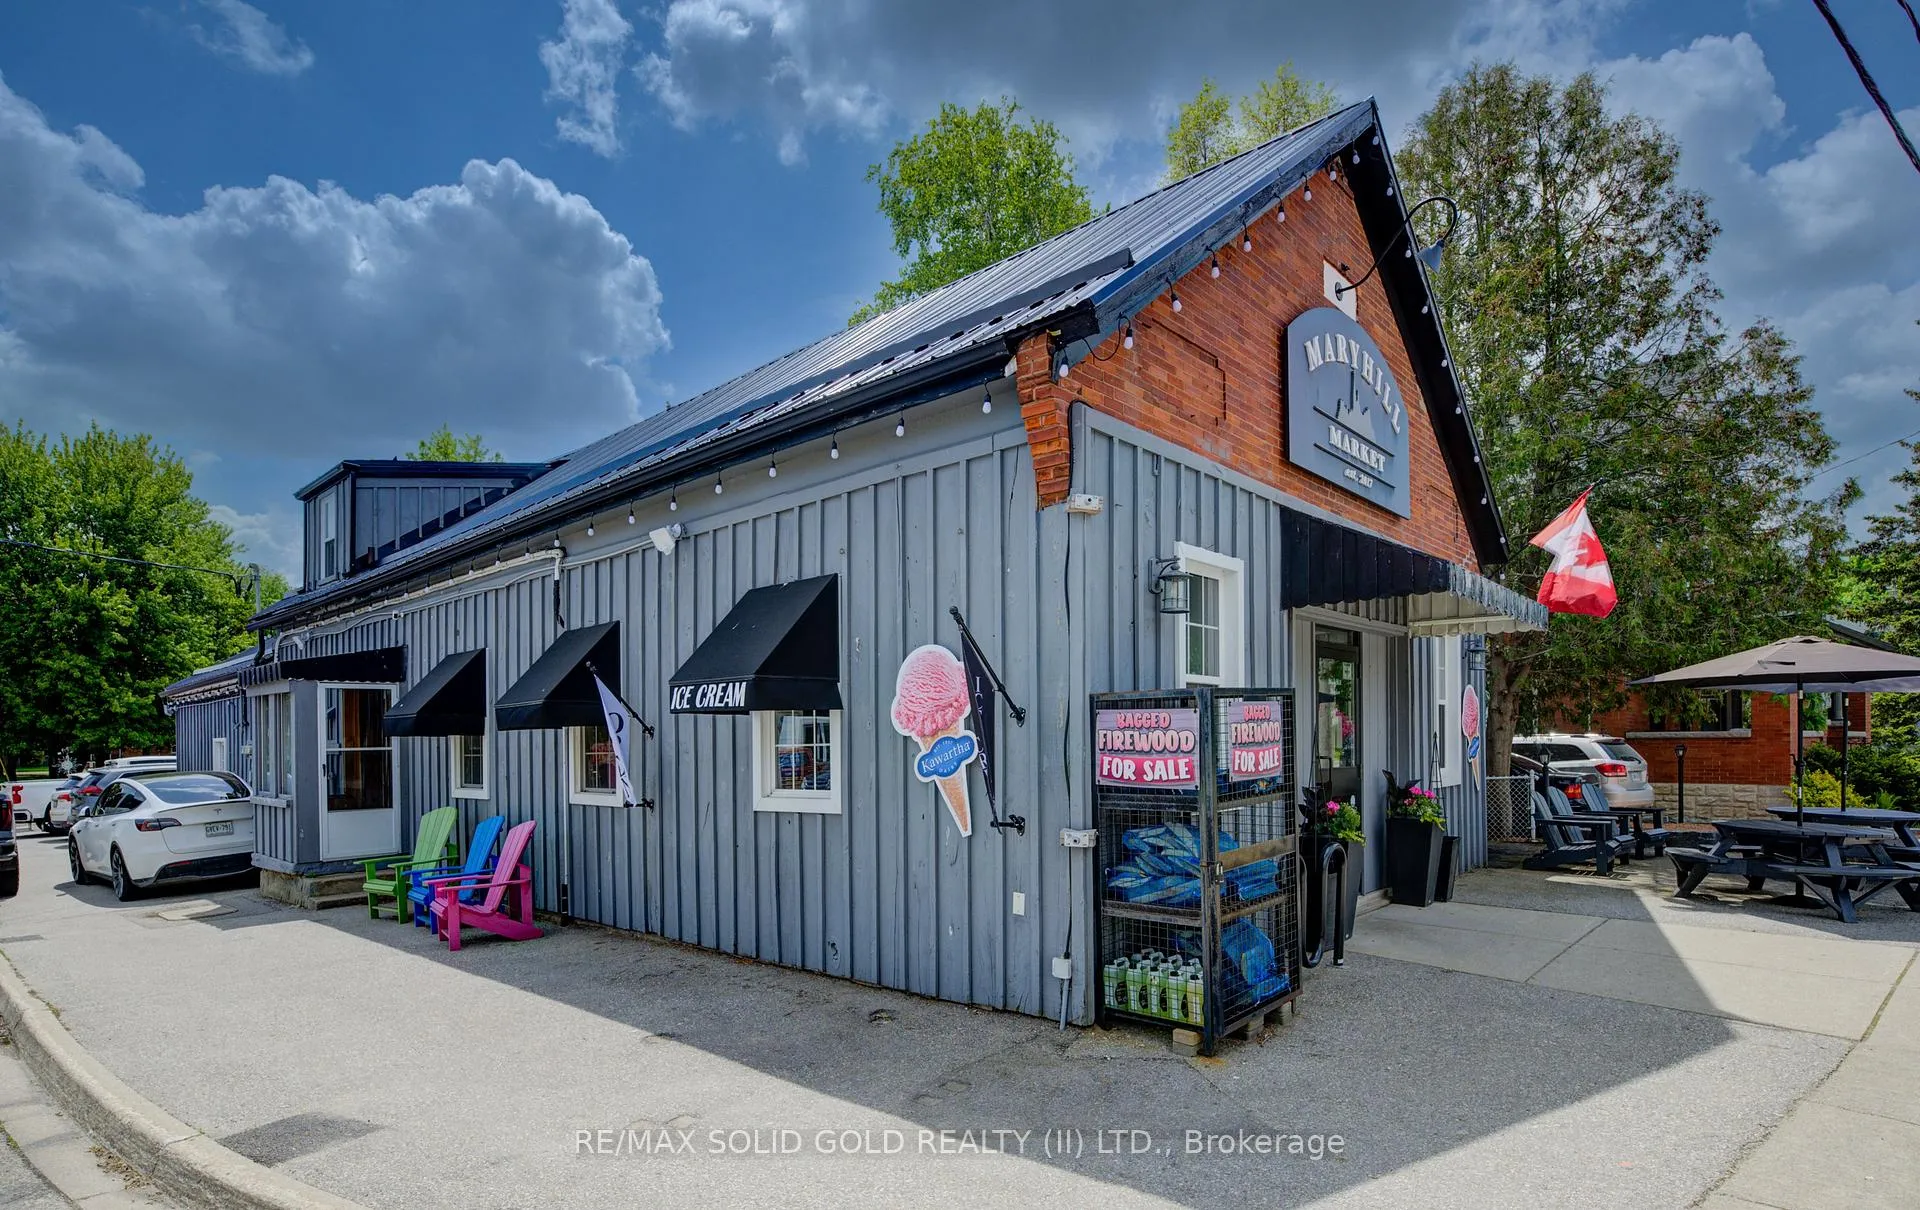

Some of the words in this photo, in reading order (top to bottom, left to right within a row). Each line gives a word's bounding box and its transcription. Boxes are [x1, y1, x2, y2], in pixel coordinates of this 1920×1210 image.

[1304, 332, 1401, 435] MARYHILL
[1328, 425, 1386, 473] MARKET
[670, 685, 694, 710] ICE
[695, 681, 747, 708] CREAM
[1116, 711, 1171, 729] BAGGED
[1243, 704, 1272, 722] BAGGED
[1098, 729, 1196, 754] FIREWOOD
[1231, 721, 1281, 745] FIREWOOD
[921, 741, 971, 774] Kawartha
[1102, 755, 1137, 781] FOR
[1143, 758, 1191, 781] SALE
[1233, 750, 1256, 773] FOR
[1258, 746, 1280, 772] SALE
